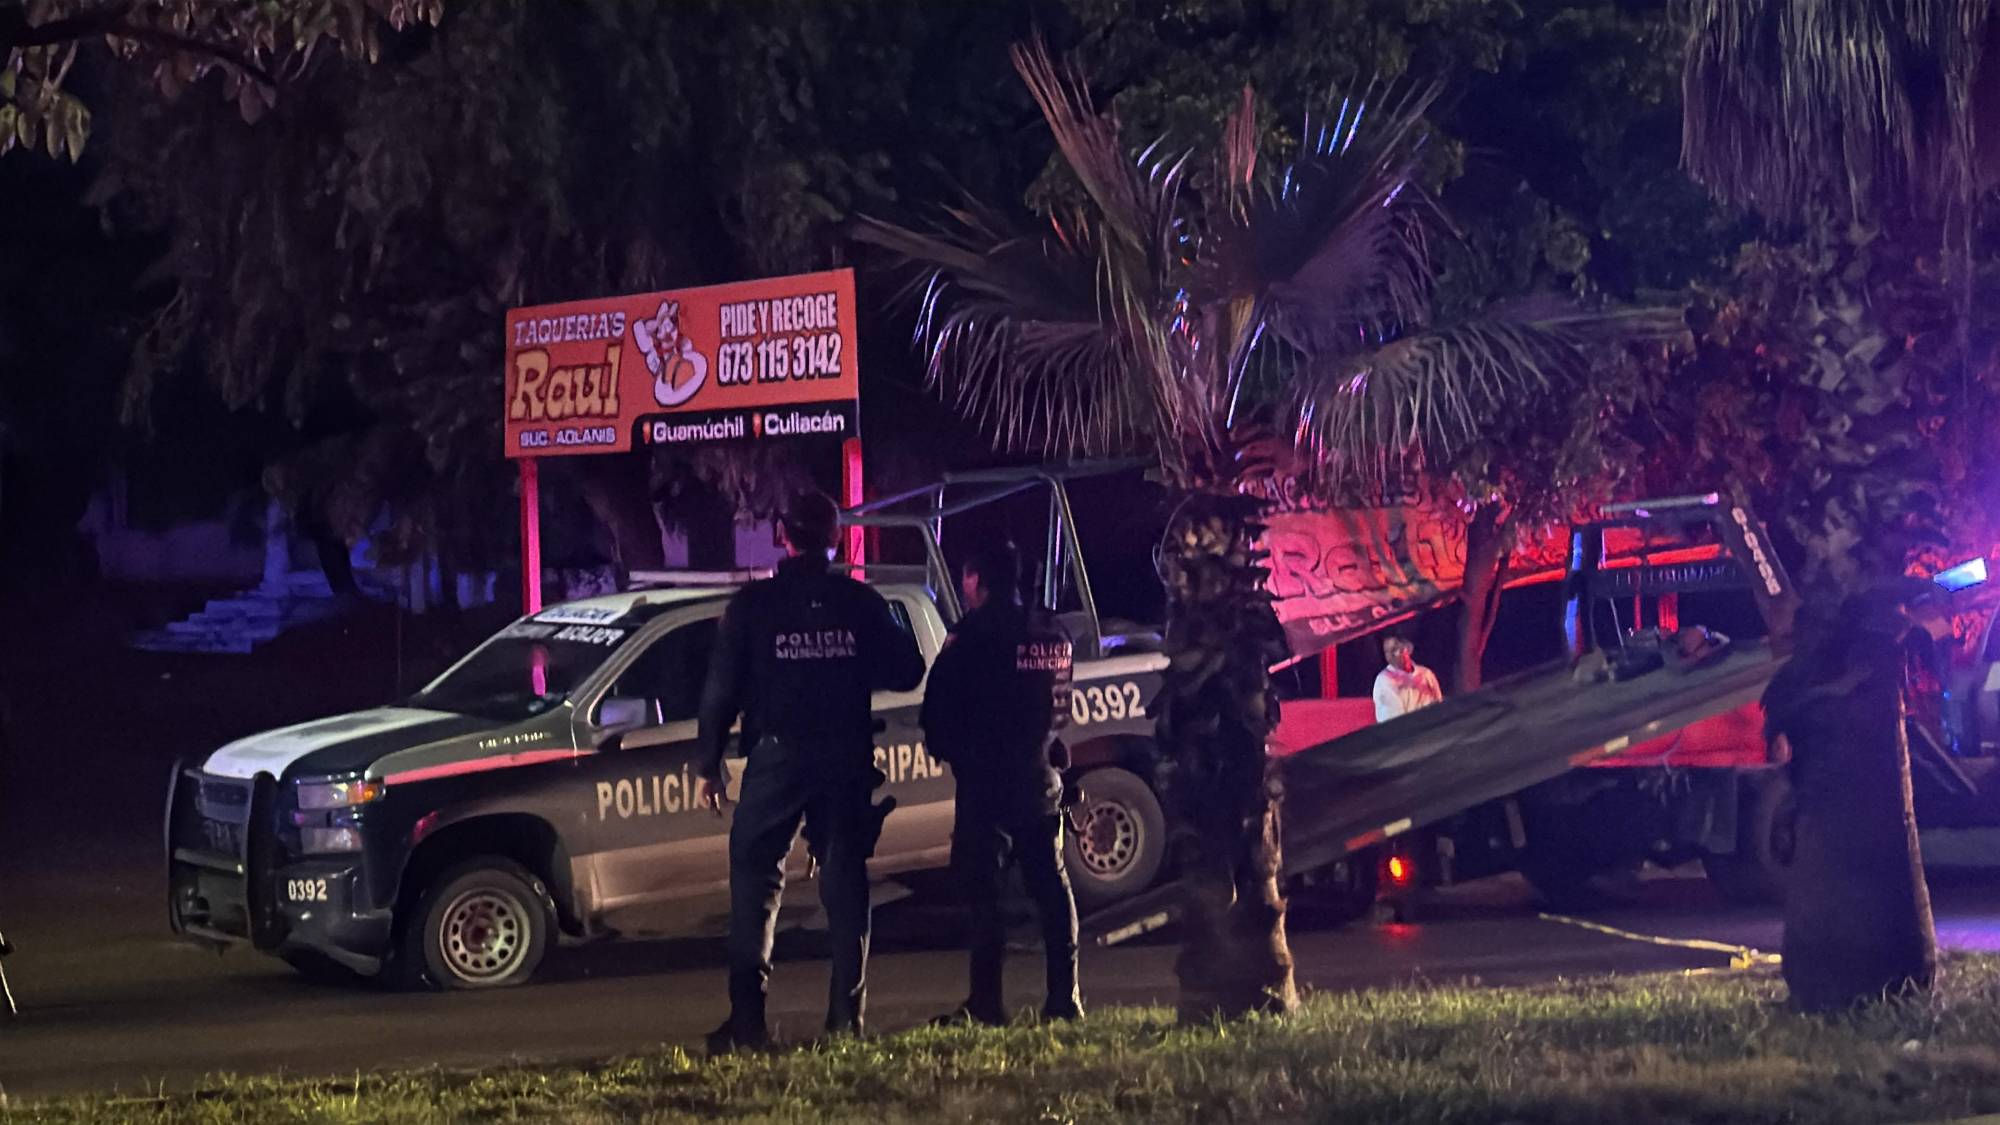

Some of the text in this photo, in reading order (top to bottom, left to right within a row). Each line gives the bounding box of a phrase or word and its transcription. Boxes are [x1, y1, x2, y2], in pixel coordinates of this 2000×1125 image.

[720, 293, 837, 338] PIDE Y RECOGE
[718, 332, 842, 384] 673 115 3142
[509, 343, 623, 421] Raul
[652, 415, 745, 444] Guamúchil
[764, 409, 846, 436] Culiacán
[1071, 680, 1146, 726] 0392
[287, 878, 328, 902] 0392
